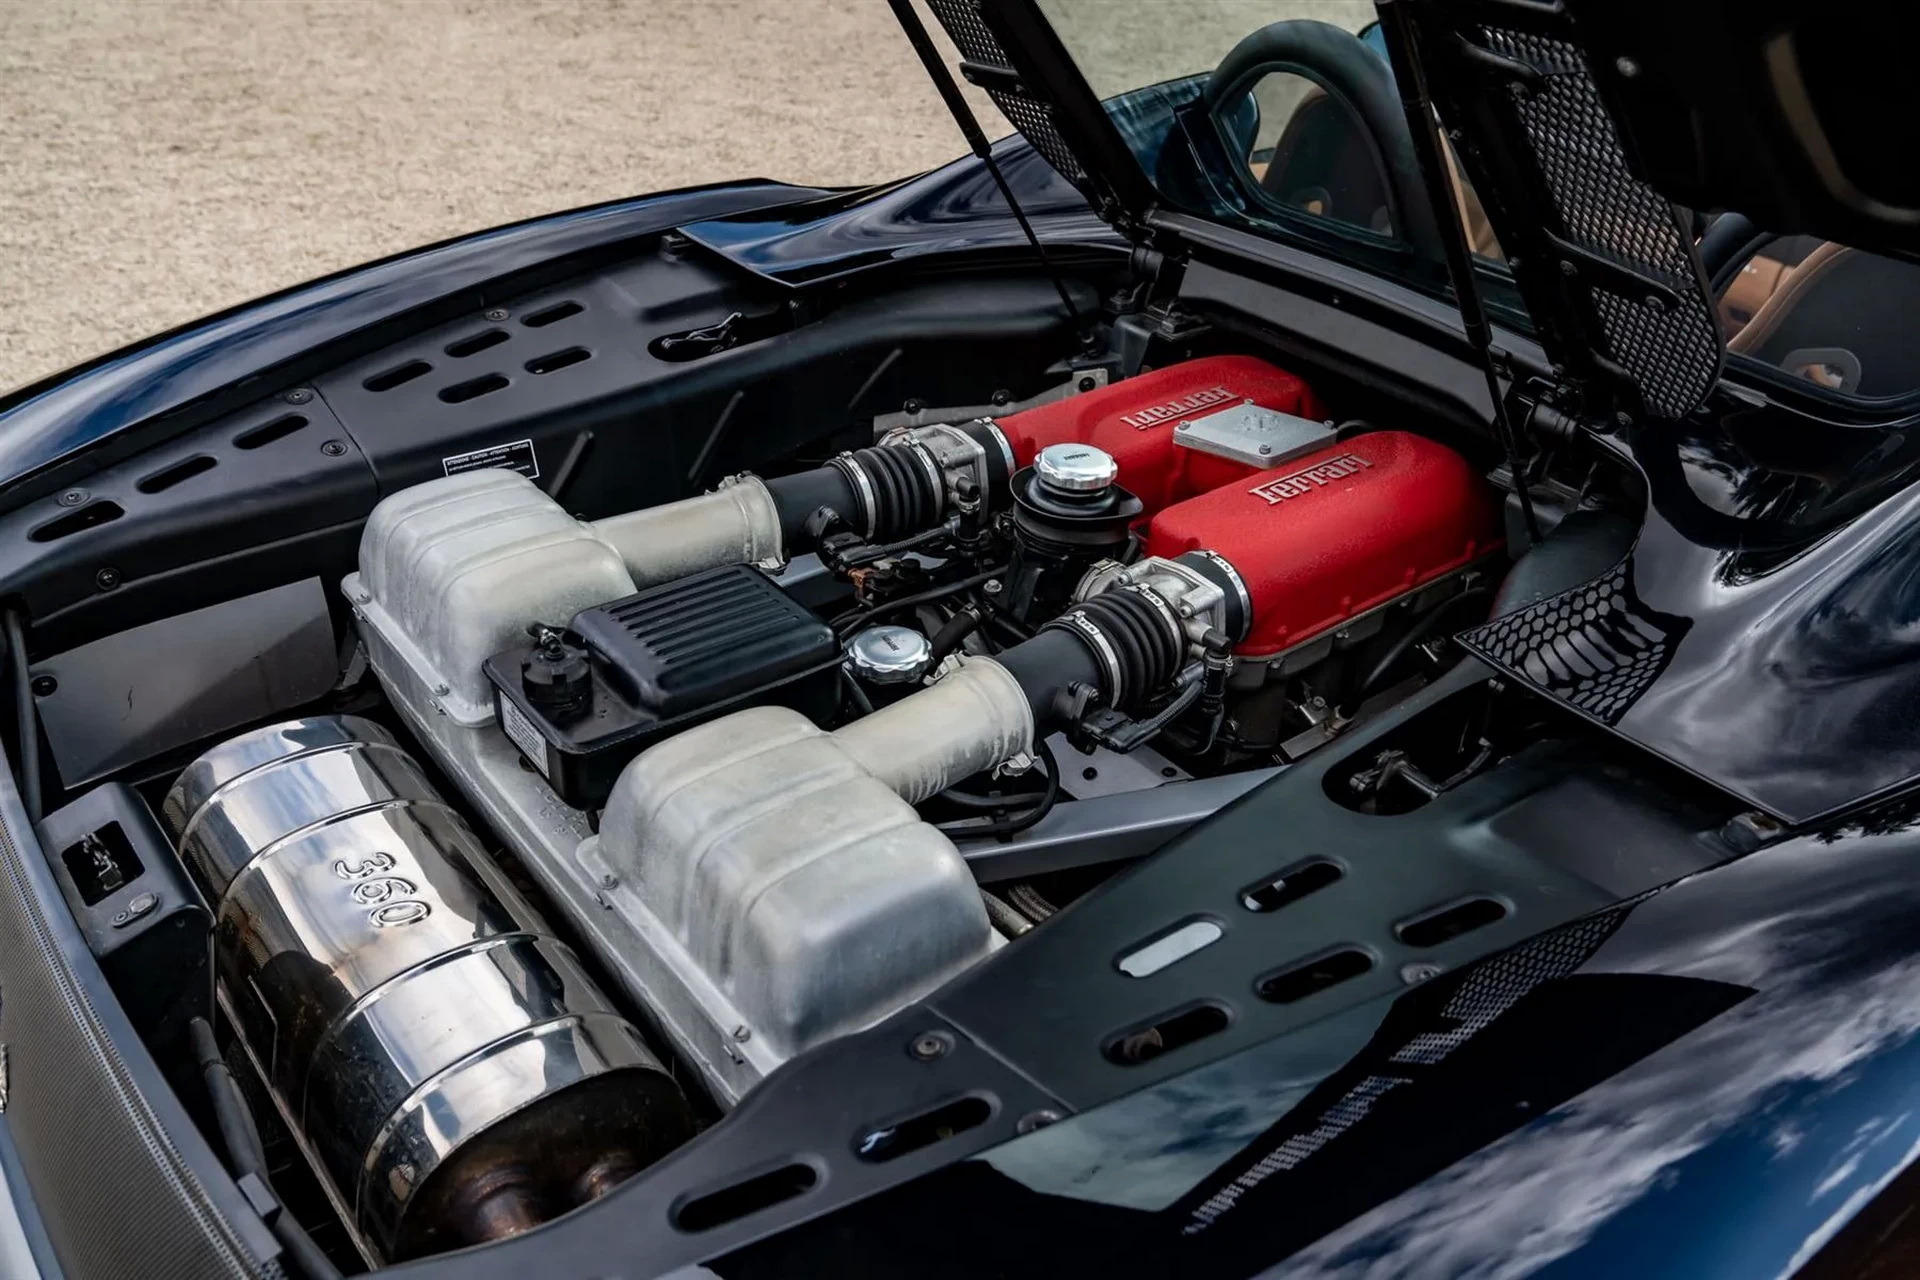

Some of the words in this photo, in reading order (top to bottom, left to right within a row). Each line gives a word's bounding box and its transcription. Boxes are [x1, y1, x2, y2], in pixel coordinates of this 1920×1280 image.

[1120, 386, 1240, 431] Ferrari
[1248, 453, 1374, 505] Ferrari
[334, 851, 432, 928] 360
